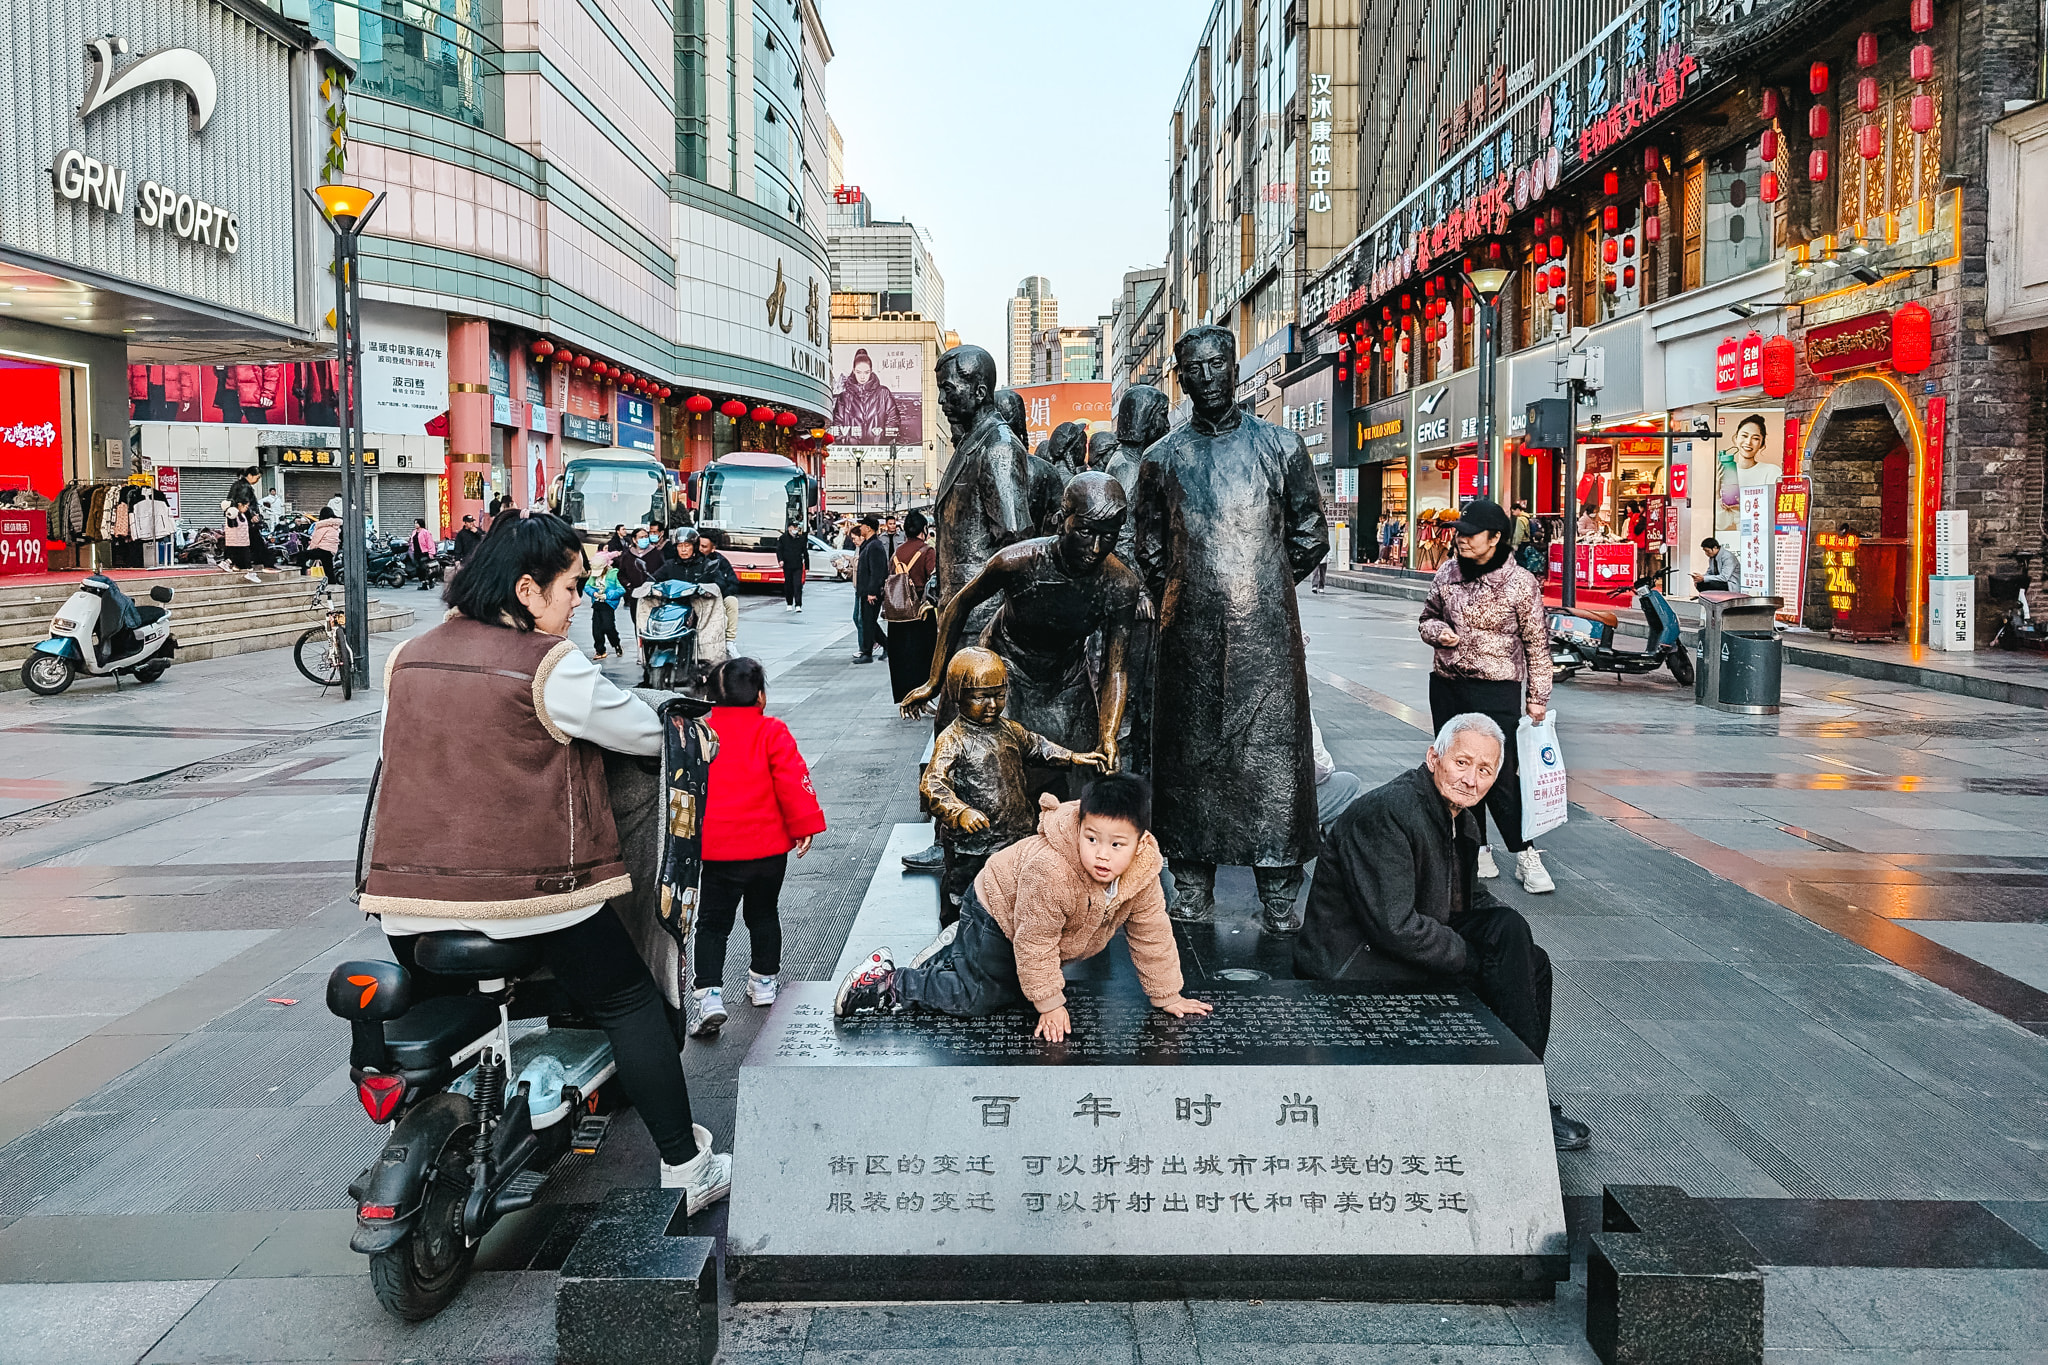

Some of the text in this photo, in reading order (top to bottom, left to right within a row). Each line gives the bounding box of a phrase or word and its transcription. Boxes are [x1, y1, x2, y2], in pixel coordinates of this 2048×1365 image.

[1310, 73, 1331, 213] 汉沐康体中心
[53, 148, 240, 254] GRN SPORTS
[369, 341, 442, 359] 温暖中国家庭47年
[1719, 352, 1736, 366] MINI
[1743, 345, 1759, 361] 名创
[791, 345, 826, 381] KOWLOON
[1743, 362, 1759, 379] 优品
[392, 376, 425, 389] 波司登
[1418, 417, 1447, 443] ERKE
[1778, 493, 1806, 512] 招聘
[1825, 550, 1854, 567] 火锅
[1827, 567, 1857, 593] 24h
[1955, 608, 1967, 642] 充电宝
[972, 1094, 1319, 1128] 百年时尚
[828, 1154, 1466, 1178] 街区的变迁 可以折射出城市和环境的变迁
[827, 1190, 1470, 1214] 服装的变迁 可以折射出时代和审美的变迁
